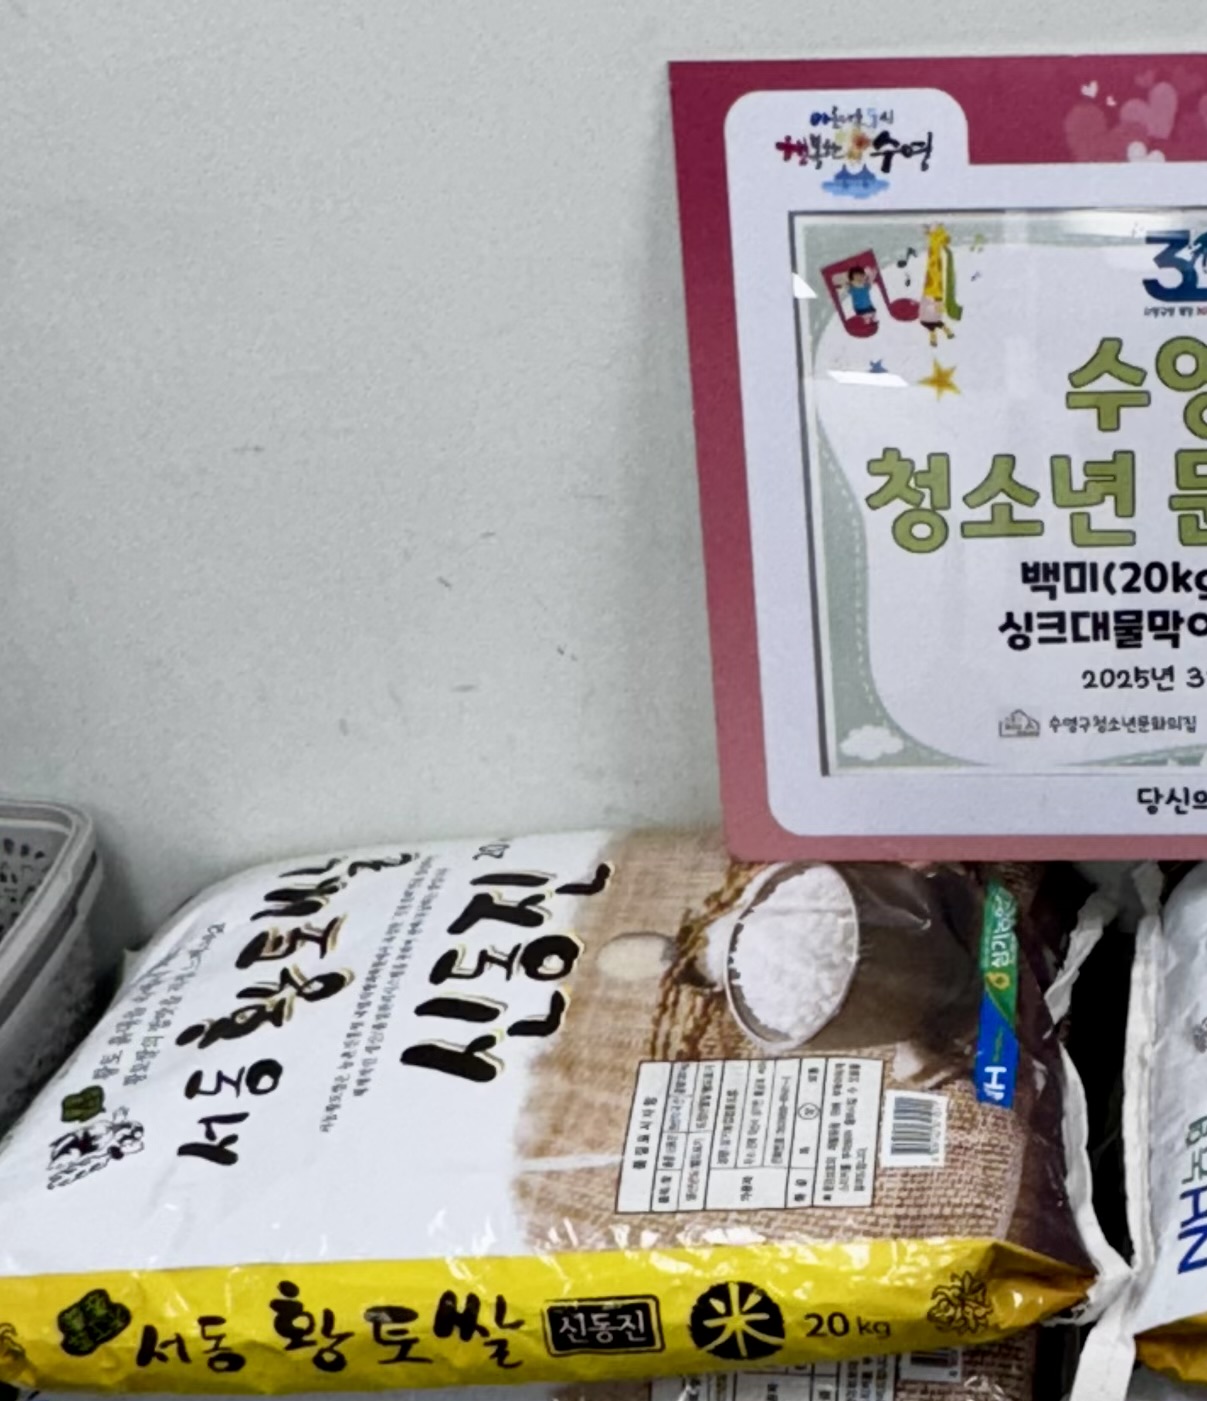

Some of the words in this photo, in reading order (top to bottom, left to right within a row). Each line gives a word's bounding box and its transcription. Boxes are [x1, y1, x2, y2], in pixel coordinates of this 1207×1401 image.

[870, 130, 933, 173] 수영
[865, 447, 1136, 554] 청소년
[1082, 665, 1174, 692] 2025년
[400, 862, 616, 1082] 신동진
[559, 1309, 646, 1344] 신동진
